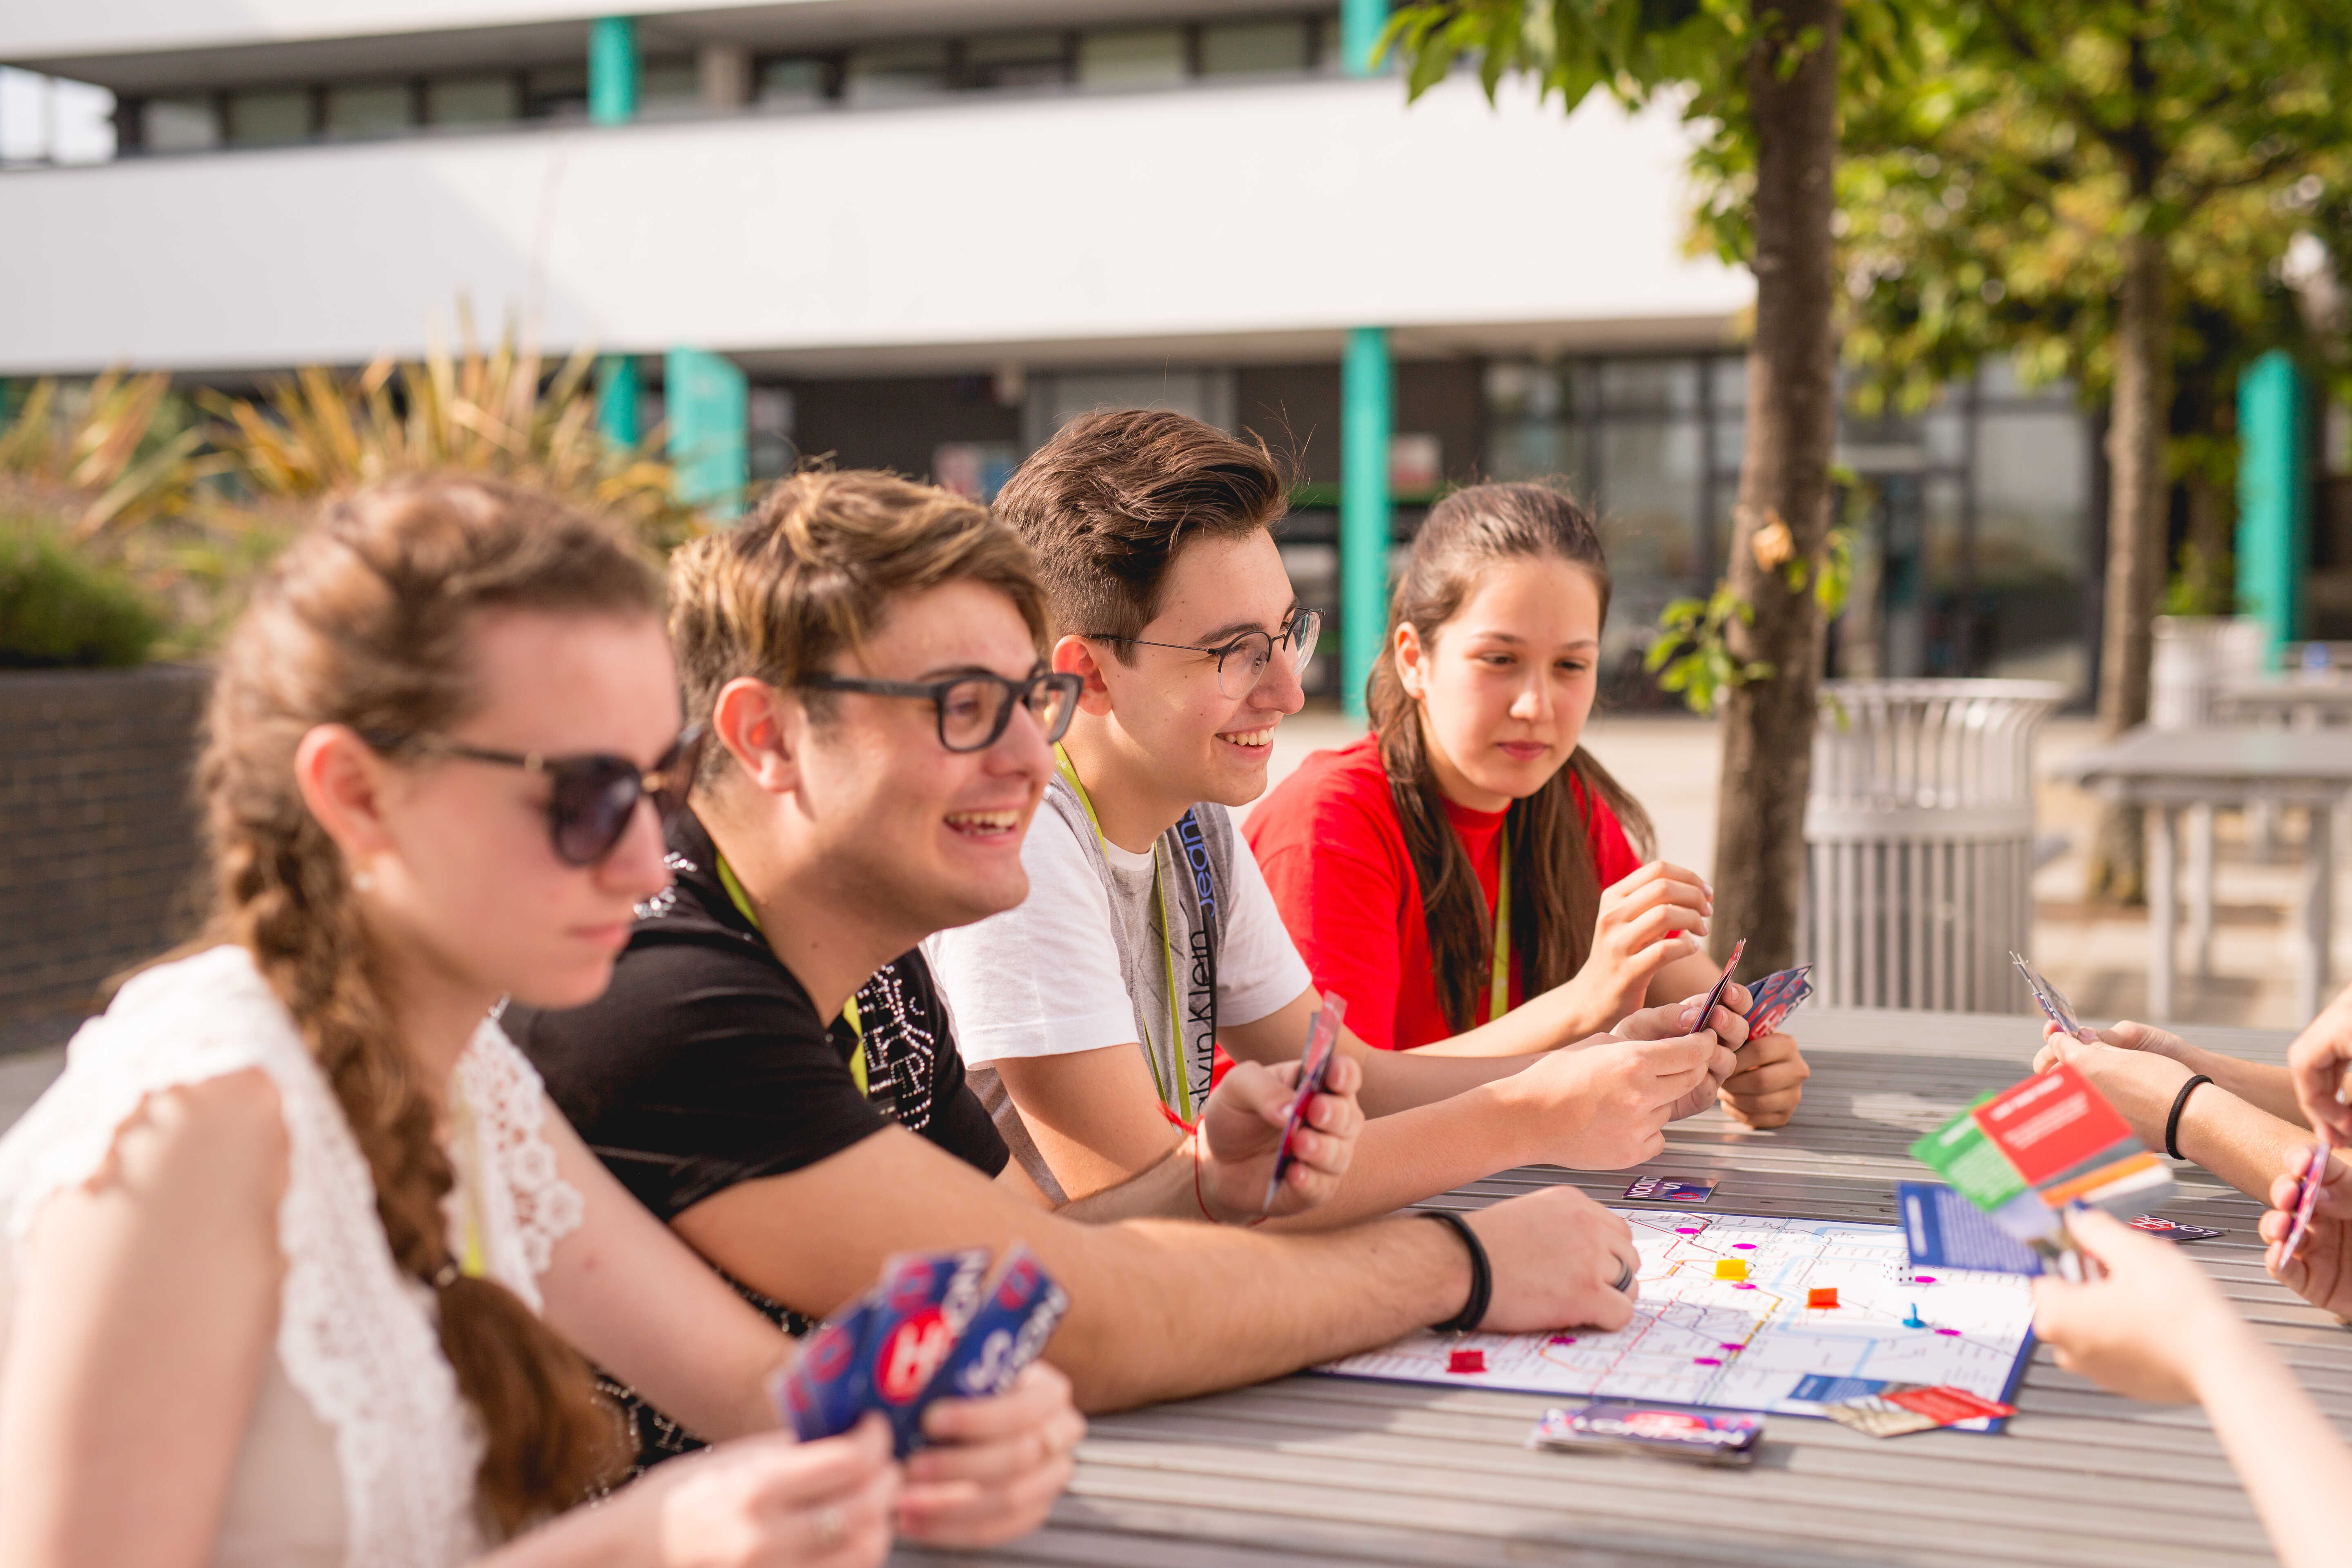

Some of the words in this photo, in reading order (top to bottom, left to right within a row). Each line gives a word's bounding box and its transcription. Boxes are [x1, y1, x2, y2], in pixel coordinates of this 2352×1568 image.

[1188, 930, 1213, 1022] Klein
[1187, 1033, 1214, 1116] alvin
[1627, 1176, 1664, 1197] LONDON
[2134, 1213, 2218, 1235] LONDO
